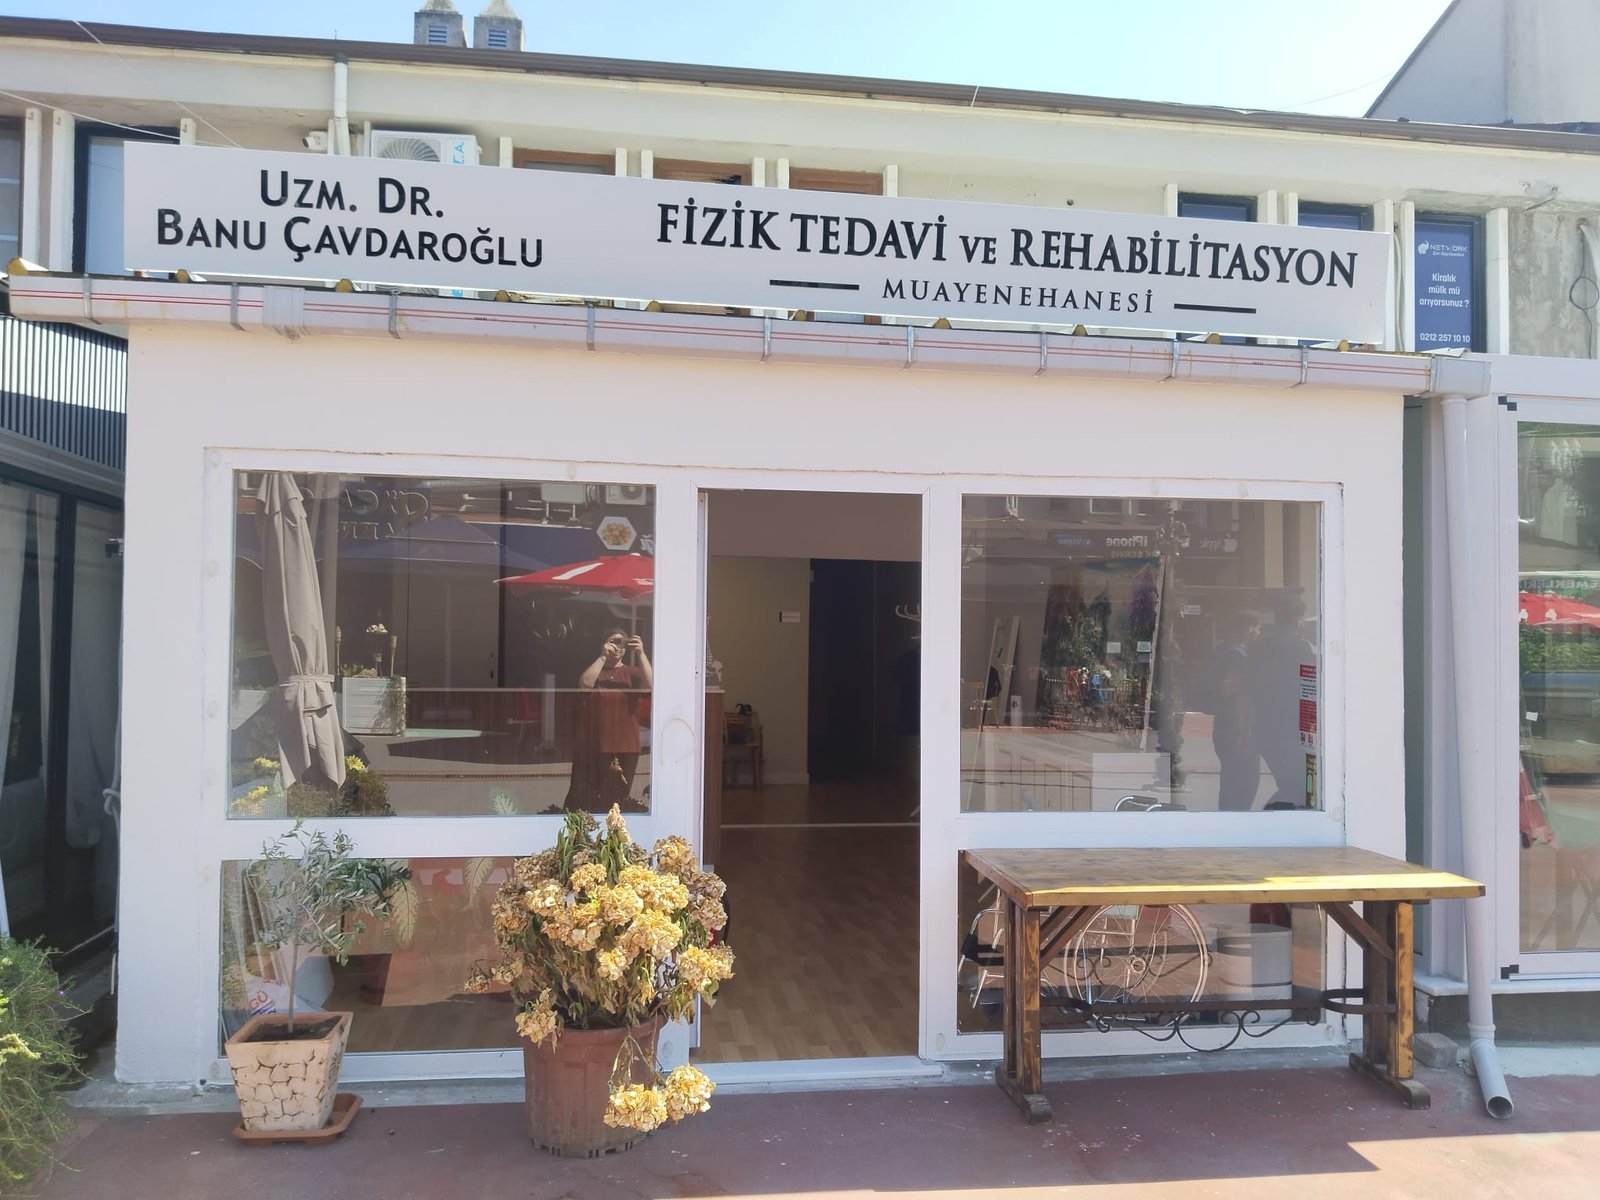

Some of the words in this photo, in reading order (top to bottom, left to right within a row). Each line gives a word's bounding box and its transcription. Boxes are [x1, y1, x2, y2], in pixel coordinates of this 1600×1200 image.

[260, 169, 357, 213] UZM.
[378, 177, 444, 218] DR.
[157, 208, 266, 251] BANU
[283, 216, 543, 268] ÇAVDAROĞLU
[656, 197, 781, 251] FİZİK
[789, 214, 948, 262] TEDAVİ
[958, 235, 997, 265] VE
[1009, 228, 1359, 289] REHABİLİTASYON
[1432, 272, 1457, 282] Kiralık
[882, 278, 1153, 314] MUAYENEHANESİ
[1428, 285, 1447, 294] mülk
[1448, 286, 1461, 295] mü
[1419, 298, 1464, 307] arıyorsunuz
[1438, 333, 1452, 342] 257
[1453, 334, 1462, 343] 10
[1462, 334, 1471, 343] 10
